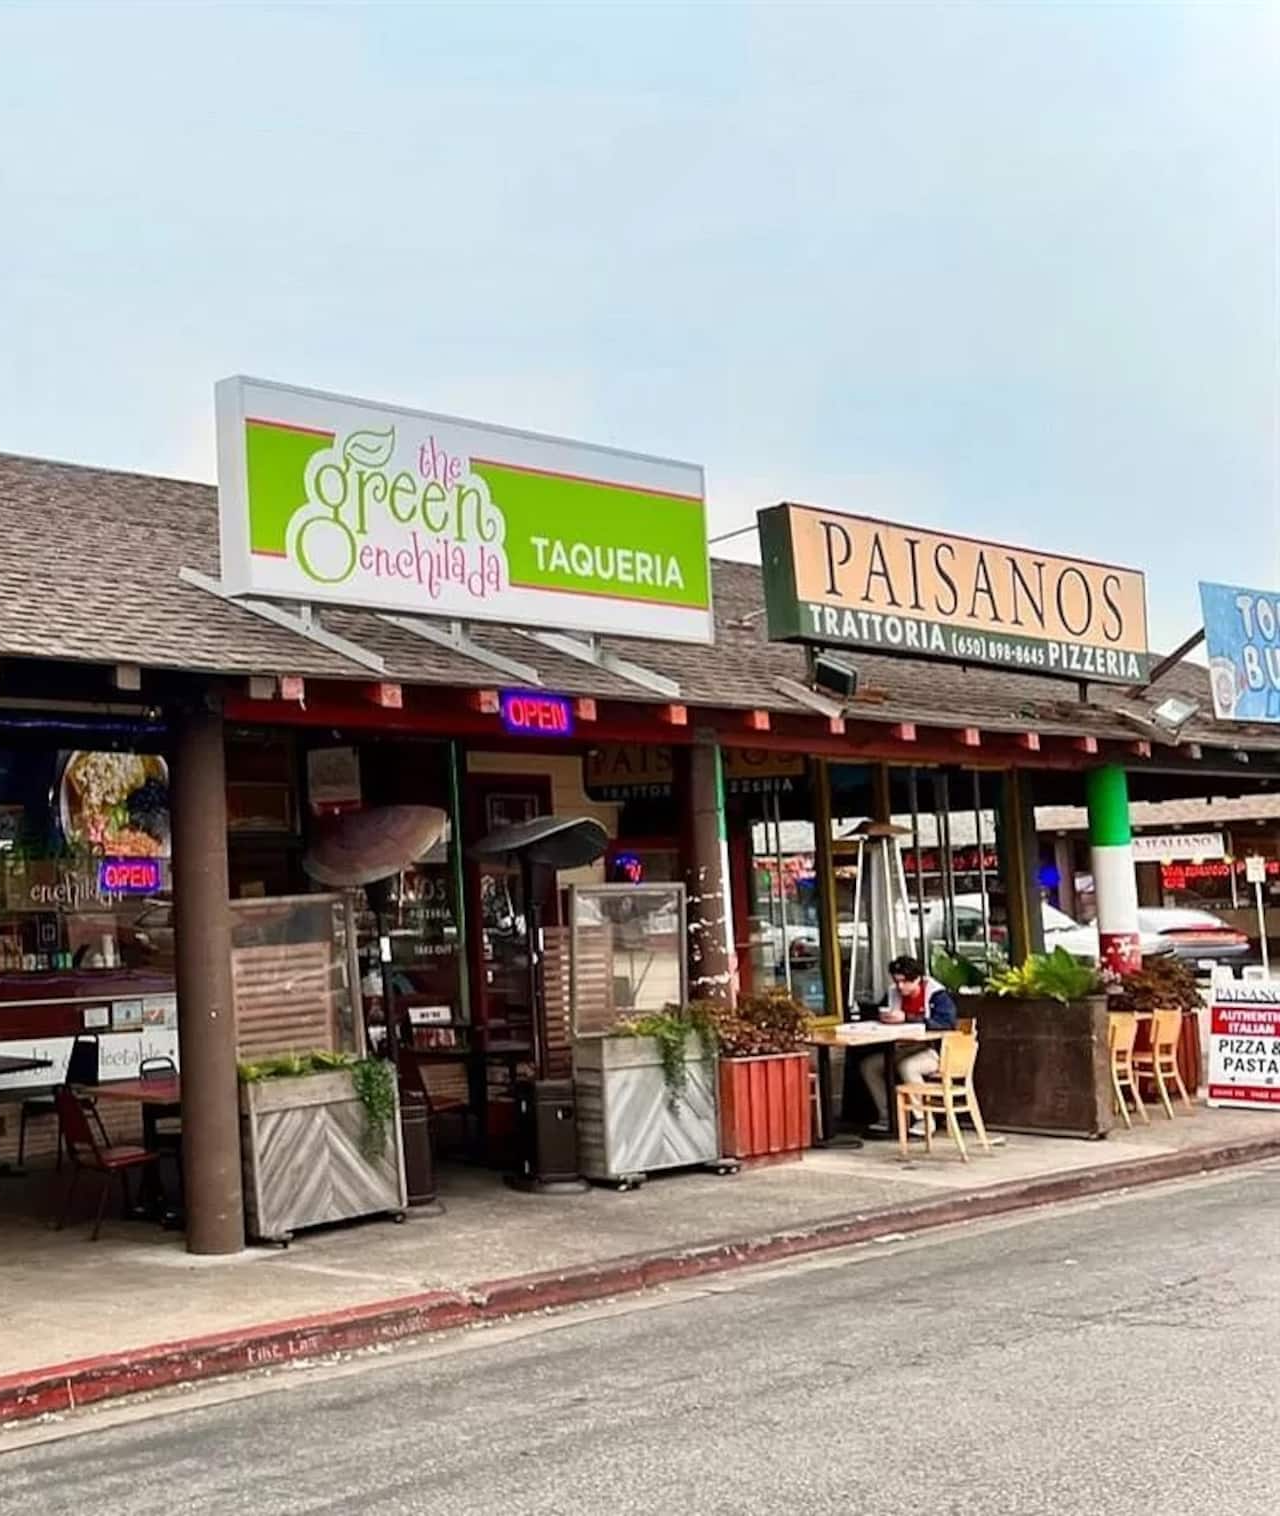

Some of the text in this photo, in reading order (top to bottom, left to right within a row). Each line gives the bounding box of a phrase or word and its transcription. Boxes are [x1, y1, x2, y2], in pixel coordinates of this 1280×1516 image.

[419, 435, 462, 490] the
[296, 455, 498, 584] green
[358, 530, 501, 600] enchilada
[530, 535, 685, 590] TAQUERIA
[819, 520, 1124, 643] PAISANOS
[809, 604, 947, 652] TRATTORIA
[950, 632, 987, 663] (650)
[1048, 641, 1141, 680] PIZZERIA
[509, 698, 569, 732] OPEN
[104, 865, 158, 888] OPEN
[1218, 1038, 1267, 1056] PIZZA
[1228, 1022, 1276, 1035] ITALIAN
[1223, 1057, 1279, 1075] PASTA
